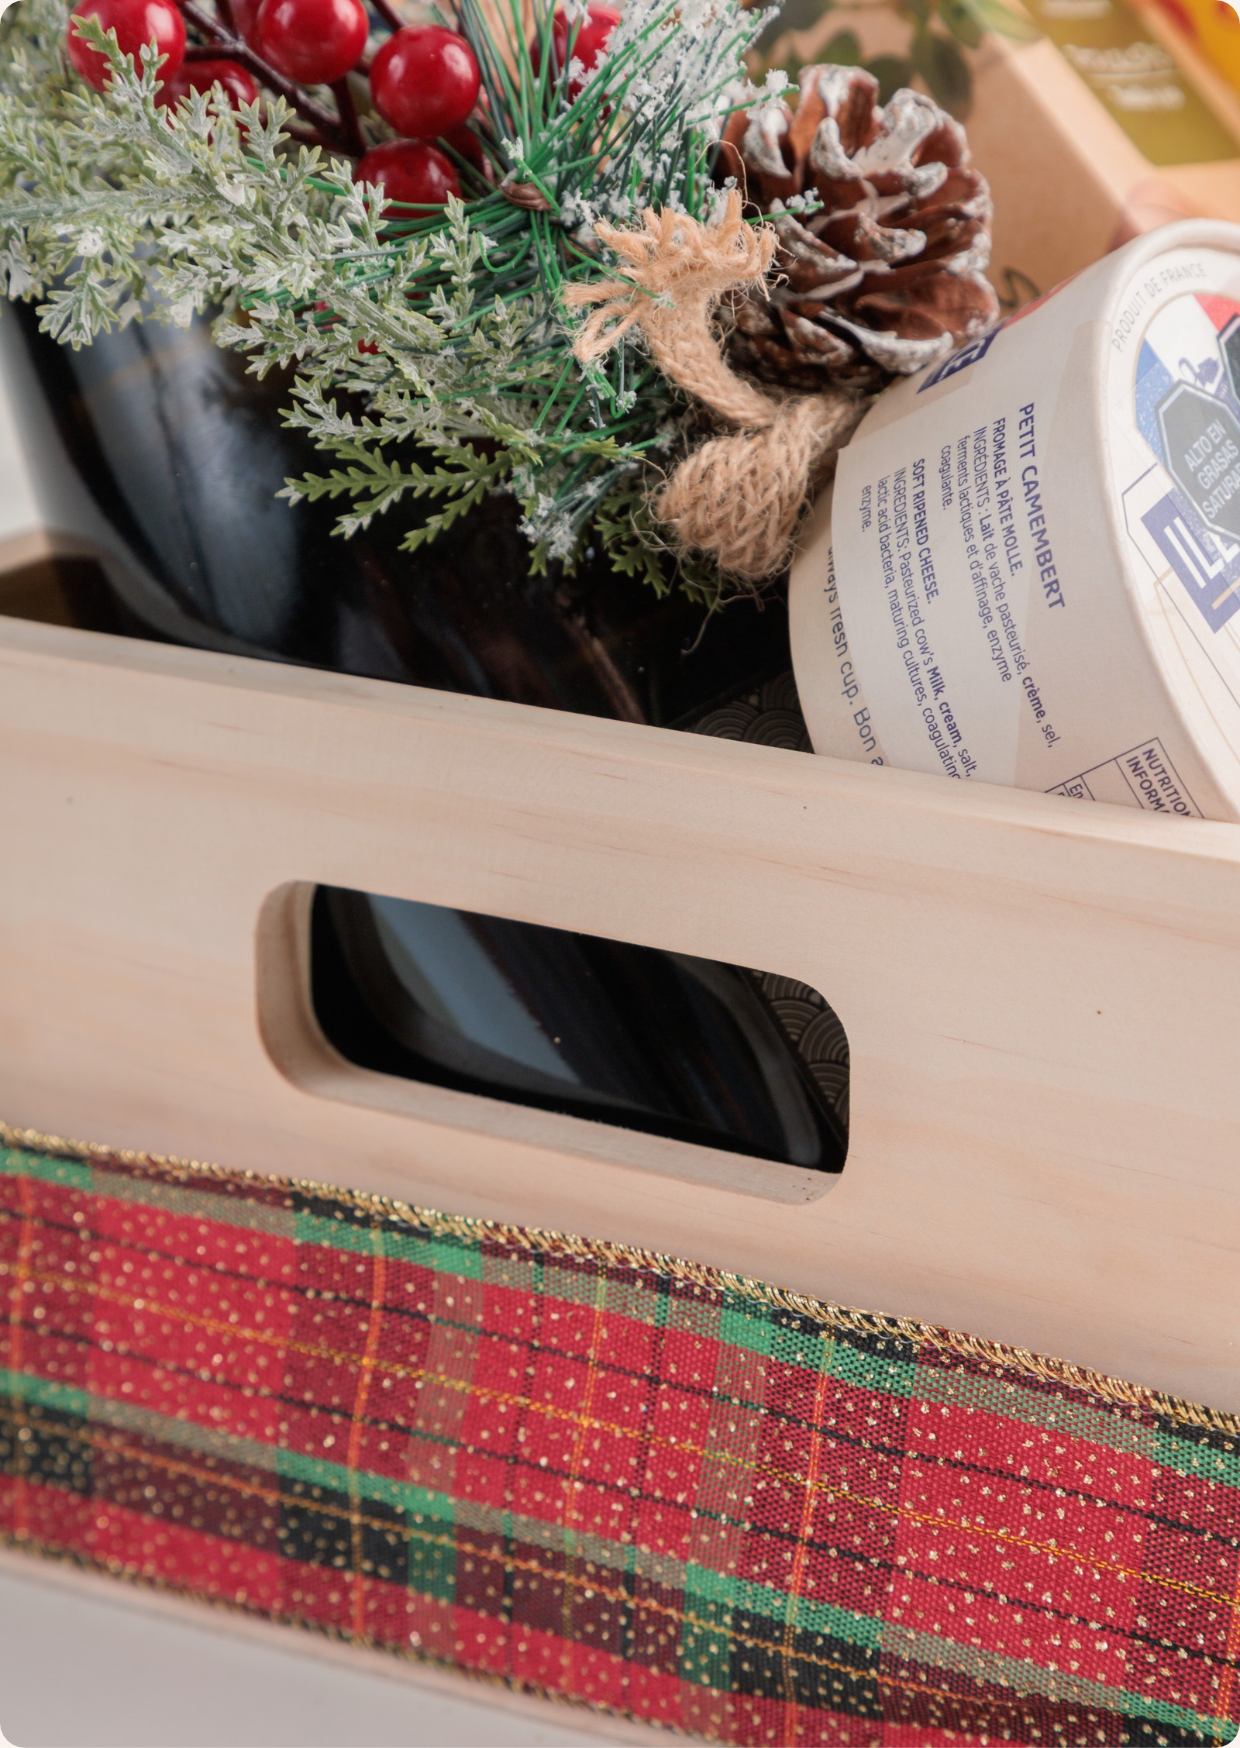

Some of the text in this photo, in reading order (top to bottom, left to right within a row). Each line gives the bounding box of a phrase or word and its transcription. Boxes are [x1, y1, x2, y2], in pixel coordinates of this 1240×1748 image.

[1111, 262, 1207, 354] PRODUIT DE FRANCE
[973, 425, 990, 508] INGRÉDIENTS
[1184, 435, 1213, 472] ALTO
[1206, 418, 1228, 445] EN
[1197, 438, 1239, 490] GRASAS
[877, 474, 891, 508] lactic
[938, 444, 955, 511] coagulante.
[993, 417, 1023, 577] FROMAGE À PÂTE MOLLE.
[1019, 402, 1066, 608] PETIT CAMEMBERT
[859, 484, 872, 533] enzyme.
[878, 507, 892, 534] acid
[912, 458, 940, 605] SOFT RIPENED CHEESE.
[979, 513, 996, 542] Lait
[879, 532, 898, 589] bacteria,
[957, 434, 1012, 683] ferments lactiques et d'affinage, enzyme
[984, 542, 998, 561] de
[988, 561, 1007, 602] vache
[887, 588, 909, 649] maturing
[893, 466, 978, 778] INGREDIENTS: Pasteurized cow's Milk, cream, salt,
[995, 603, 1031, 676] pasteurisé,
[840, 661, 860, 706] cup.
[853, 706, 878, 752] Bon
[902, 650, 927, 707] cultures,
[1022, 676, 1047, 724] crème,
[1041, 724, 1062, 748] sel,
